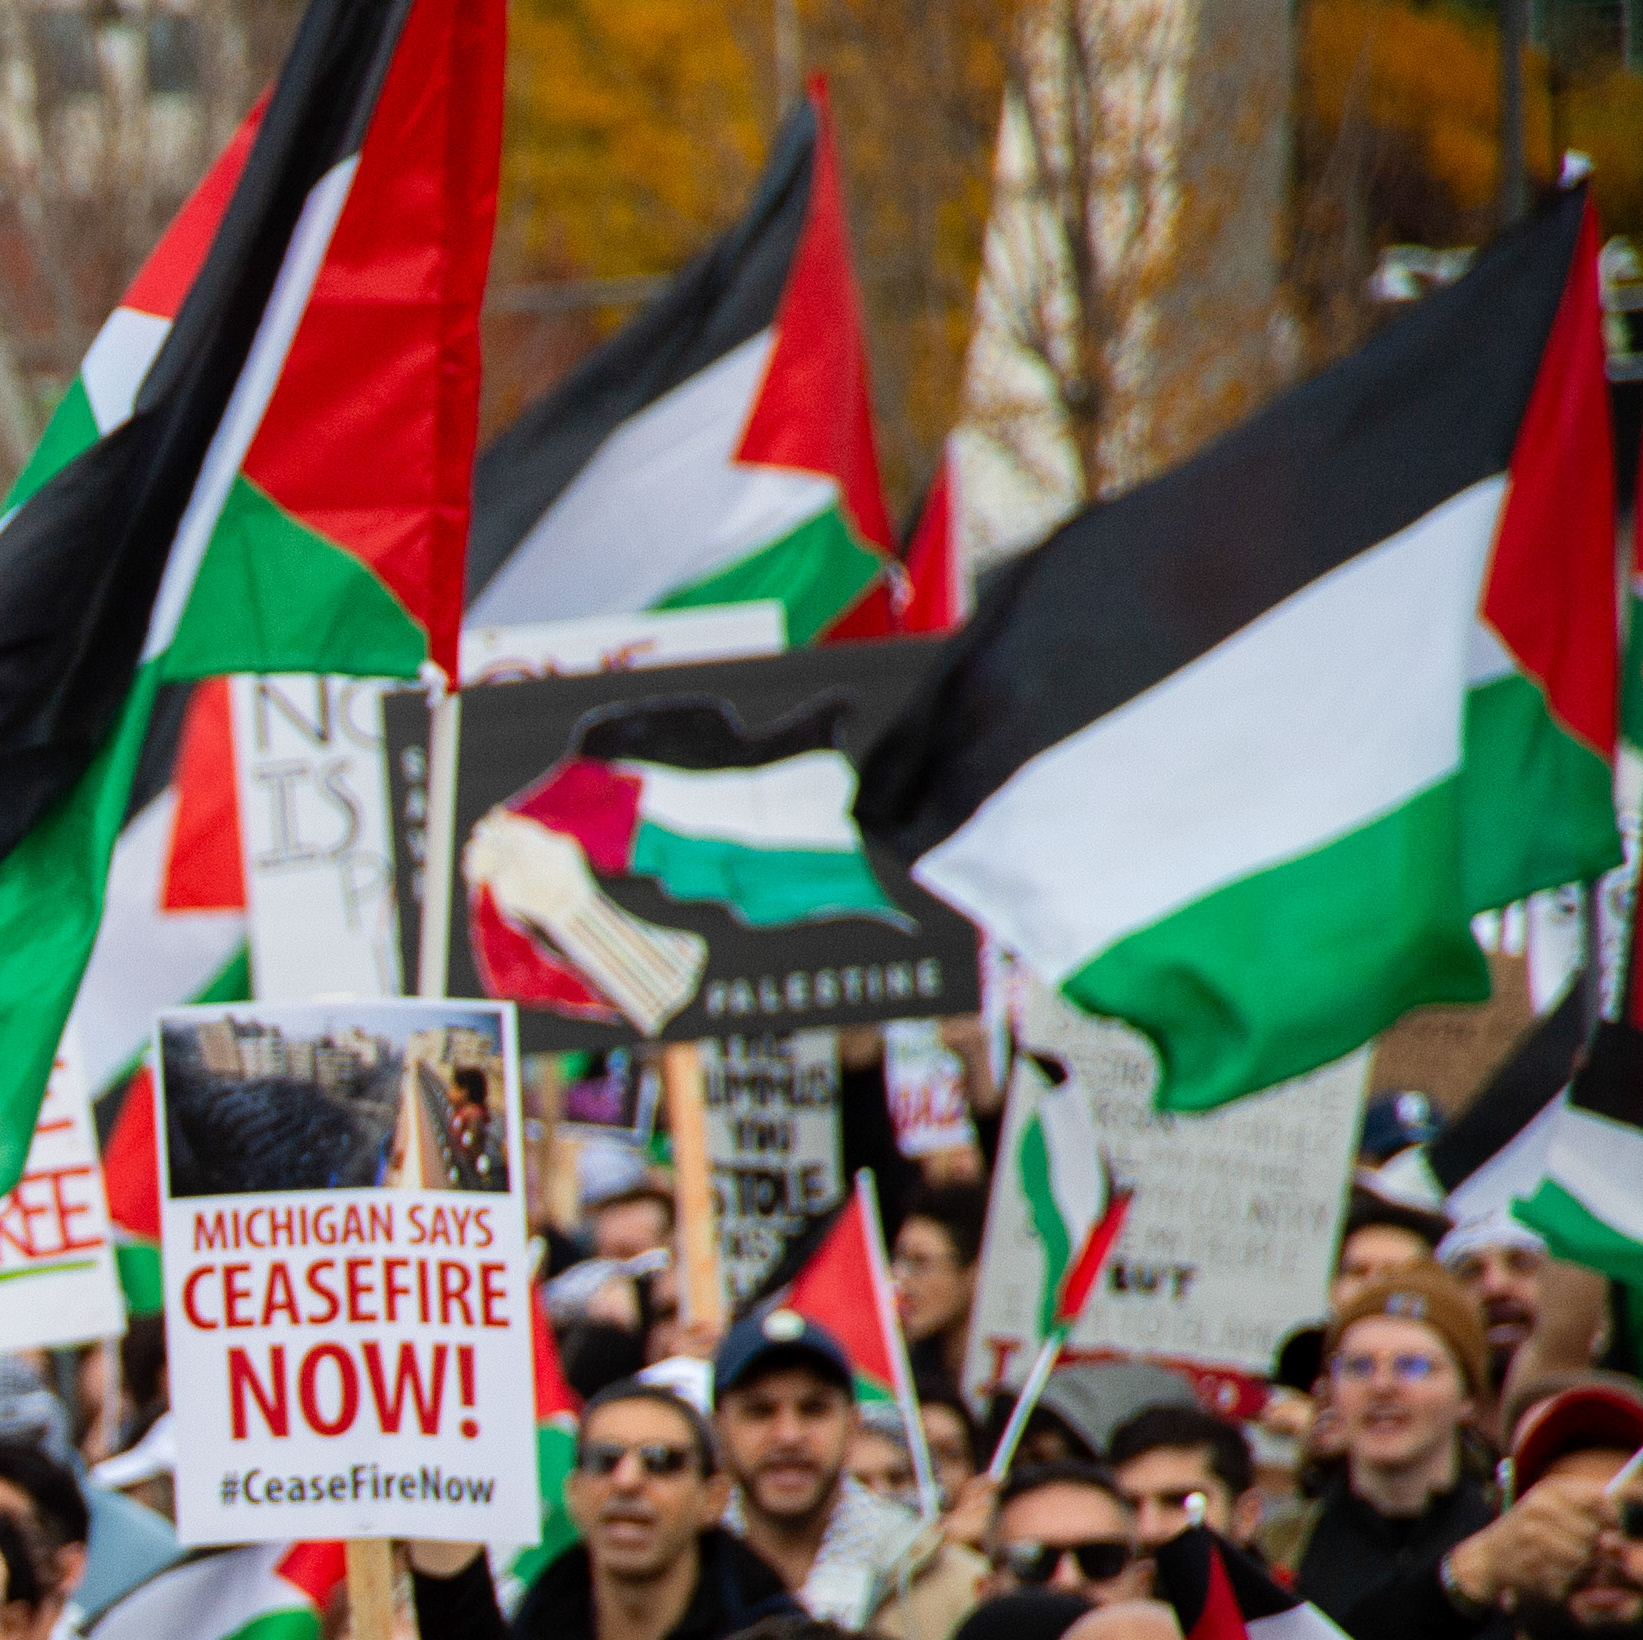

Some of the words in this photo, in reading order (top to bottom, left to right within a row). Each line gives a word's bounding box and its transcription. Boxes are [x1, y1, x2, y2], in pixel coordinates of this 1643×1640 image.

[193, 1203, 396, 1251] MICHIGAN
[408, 1206, 494, 1248] SAYS
[183, 1257, 511, 1330] CEASEFIRE
[227, 1340, 480, 1441] NOW!
[220, 1465, 496, 1504] #CeaseFireNow
